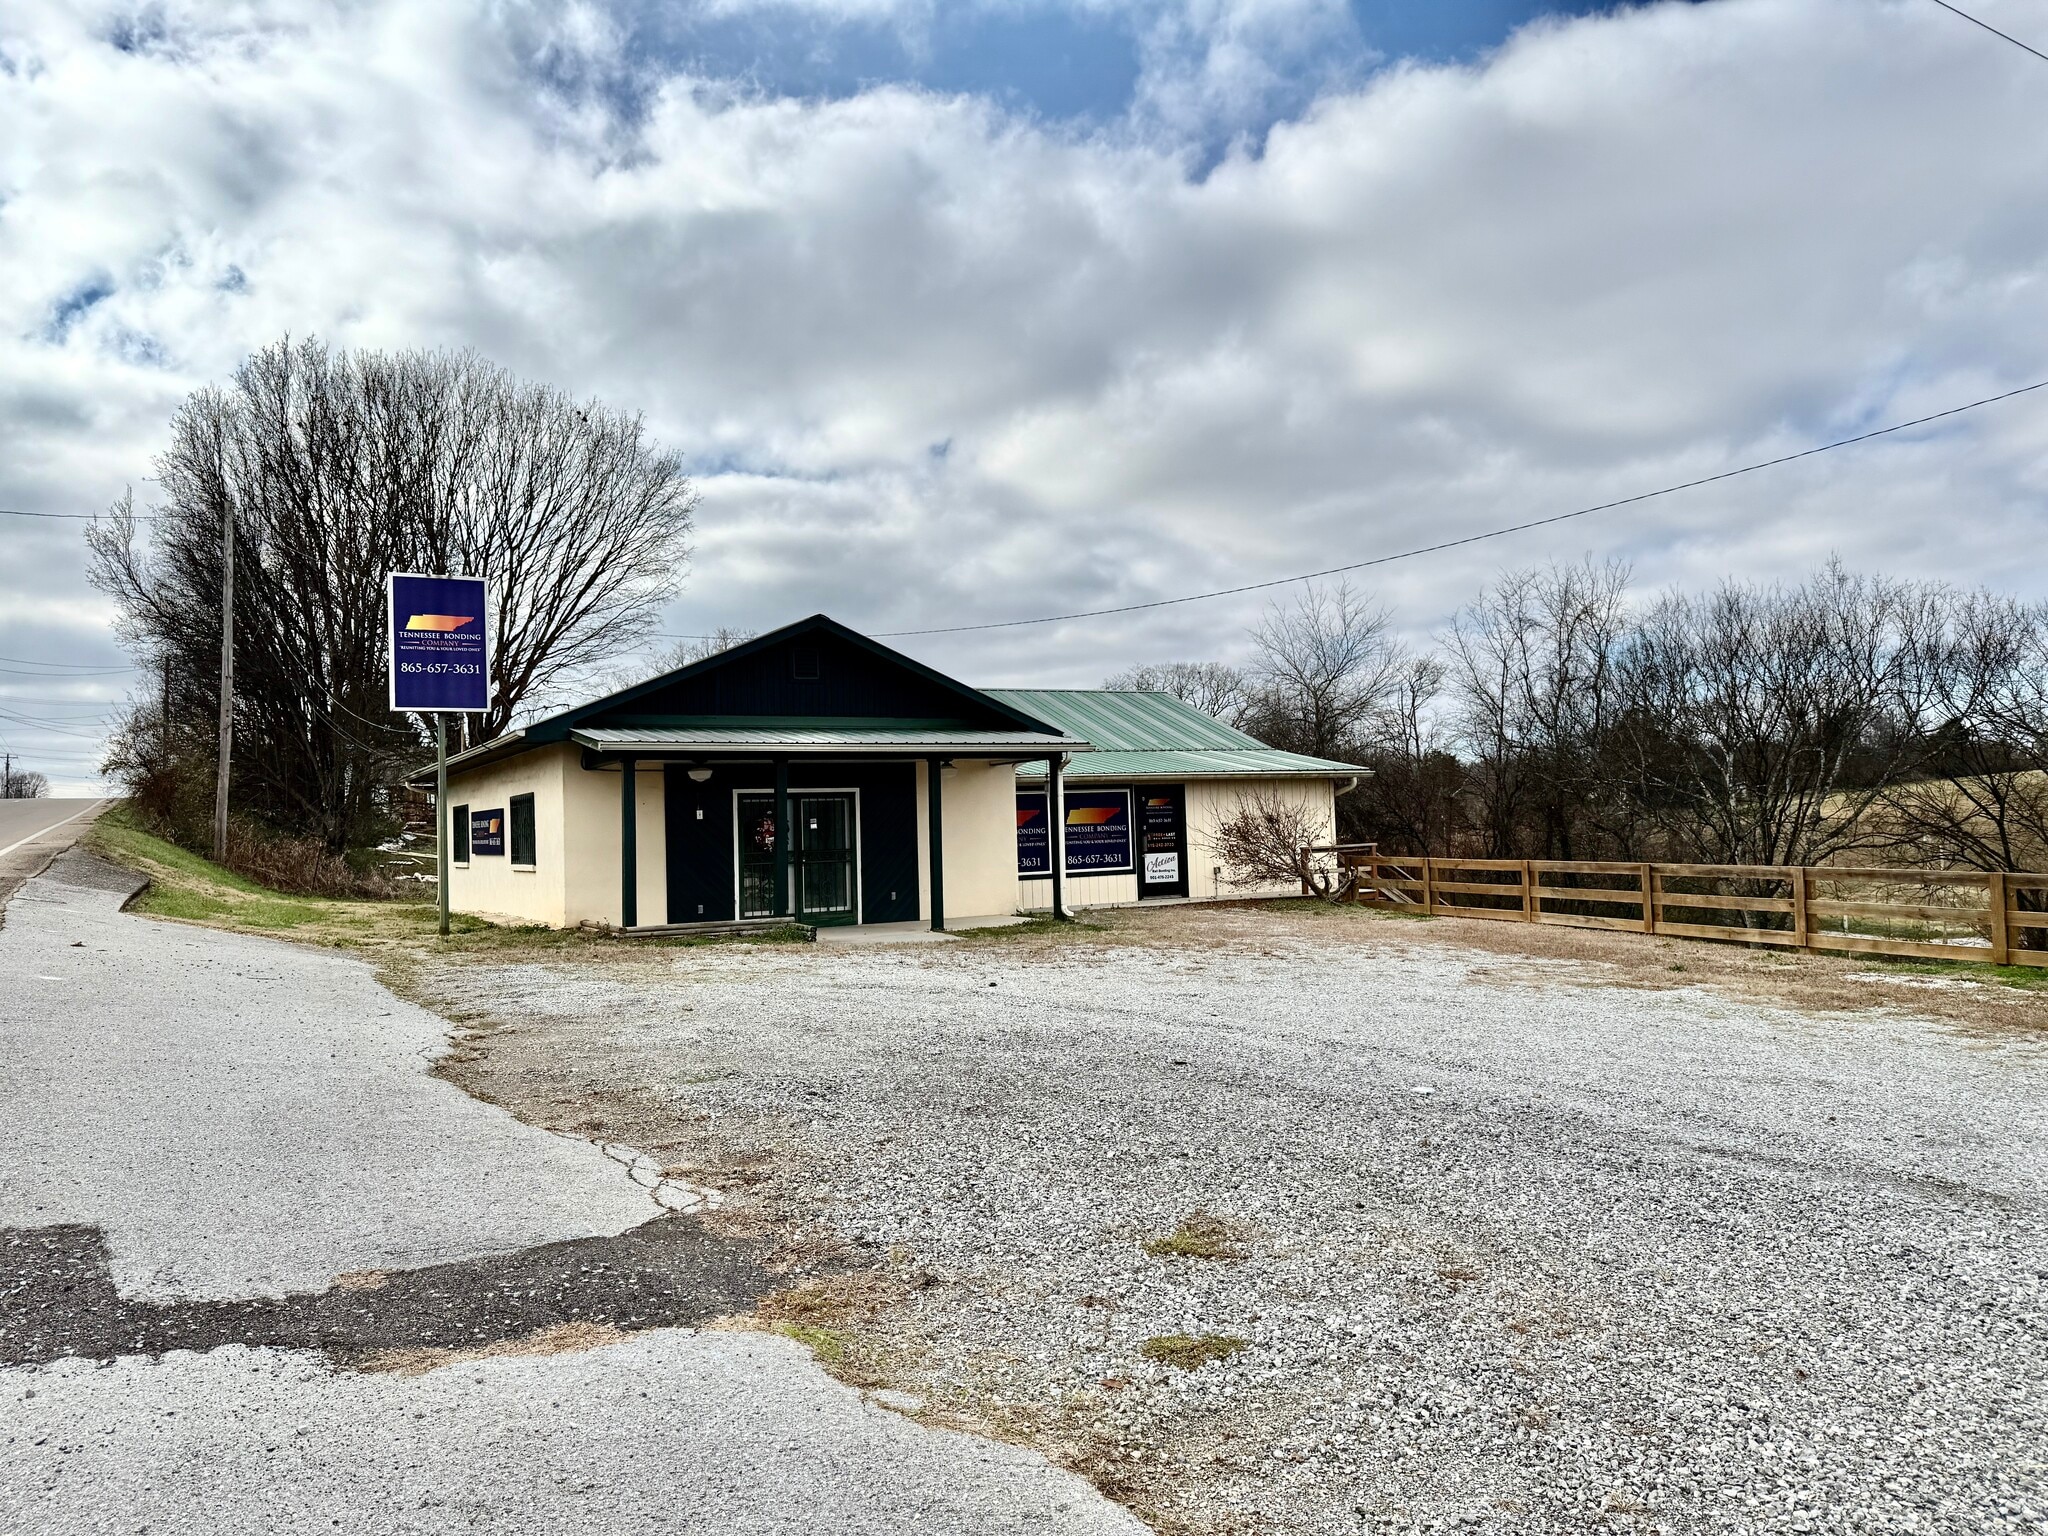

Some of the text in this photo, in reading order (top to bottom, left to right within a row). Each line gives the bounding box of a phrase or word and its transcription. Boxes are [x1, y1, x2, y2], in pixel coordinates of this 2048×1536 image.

[398, 631, 481, 641] TENNESSEE BONDING
[421, 639, 460, 647] COMPANY
[400, 662, 481, 674] 865-657-3631
[1017, 827, 1046, 835] ONDING
[1067, 853, 1123, 865] 865-657-3631
